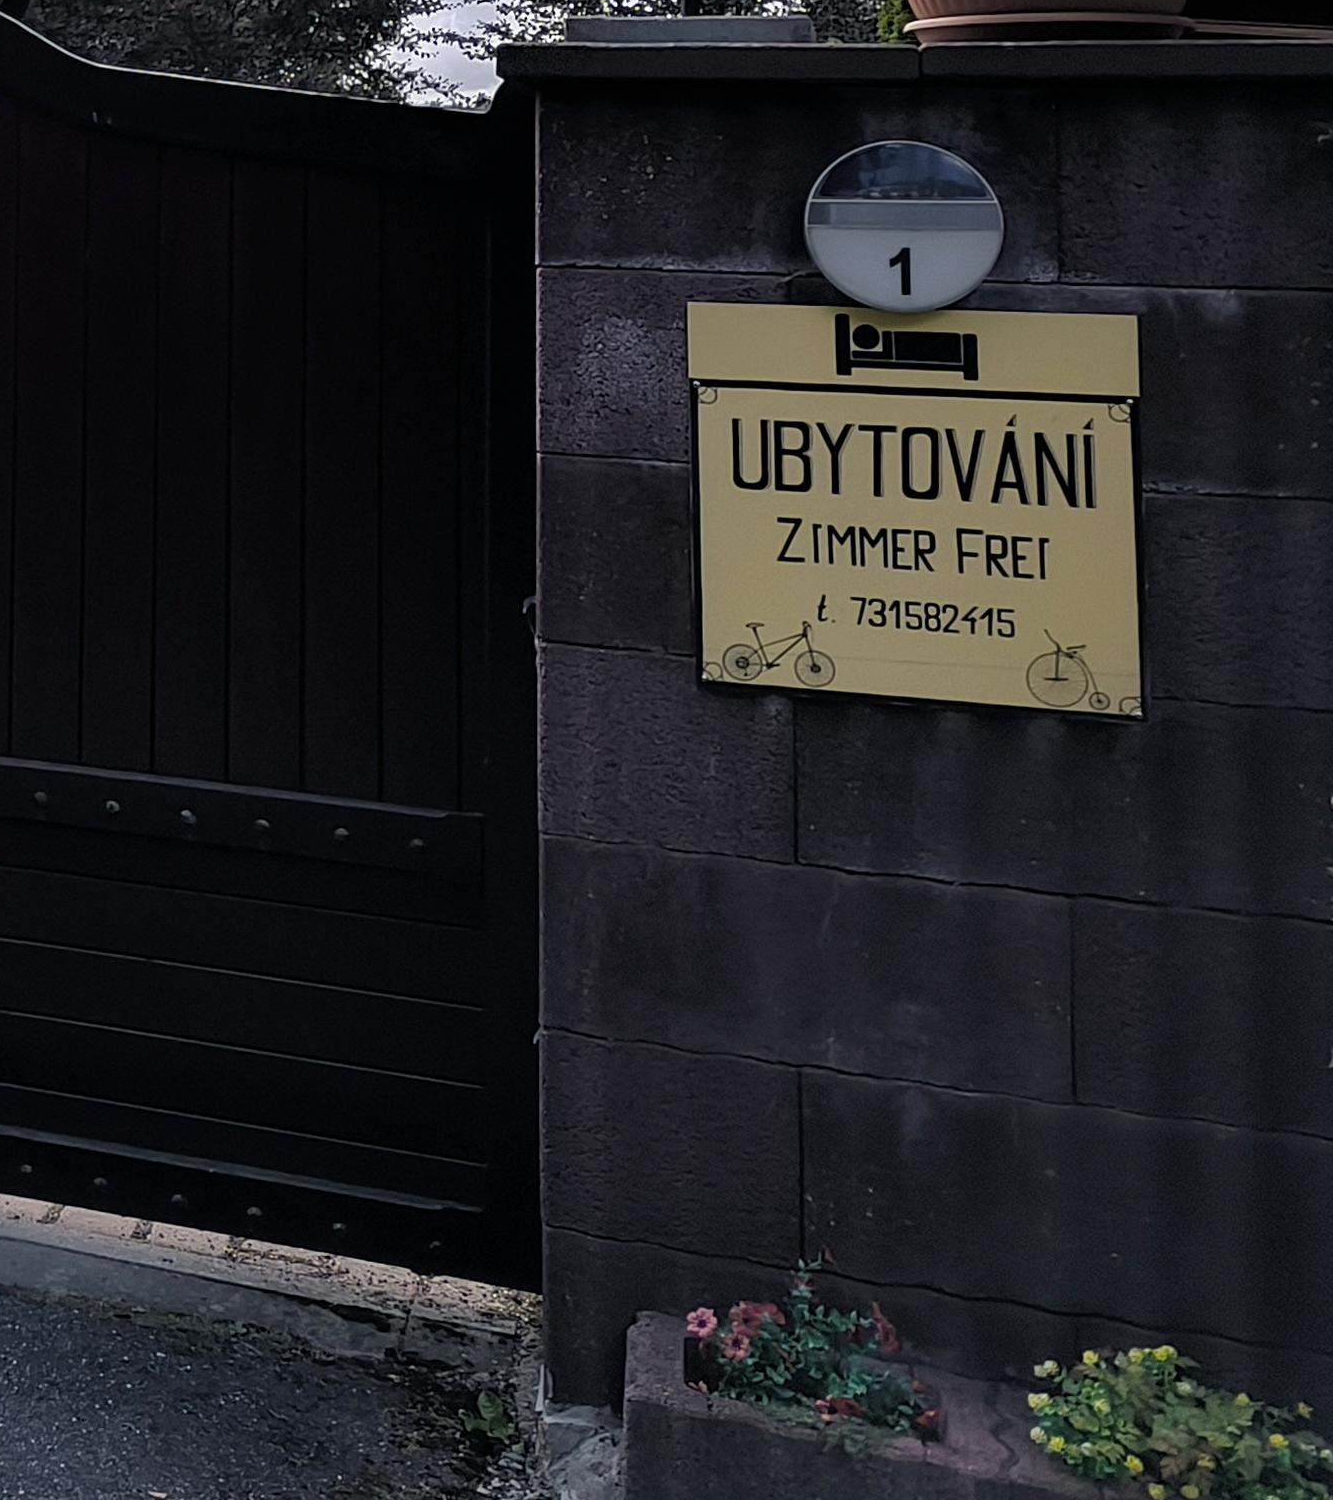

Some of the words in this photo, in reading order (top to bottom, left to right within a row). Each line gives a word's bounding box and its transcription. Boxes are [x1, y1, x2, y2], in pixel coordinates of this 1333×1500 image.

[888, 247, 912, 296] 1
[731, 414, 1098, 509] UBYTOVÁNÍ
[776, 516, 936, 572] ZIMMER
[956, 528, 1051, 580] FREI
[849, 596, 1016, 639] 731582415
